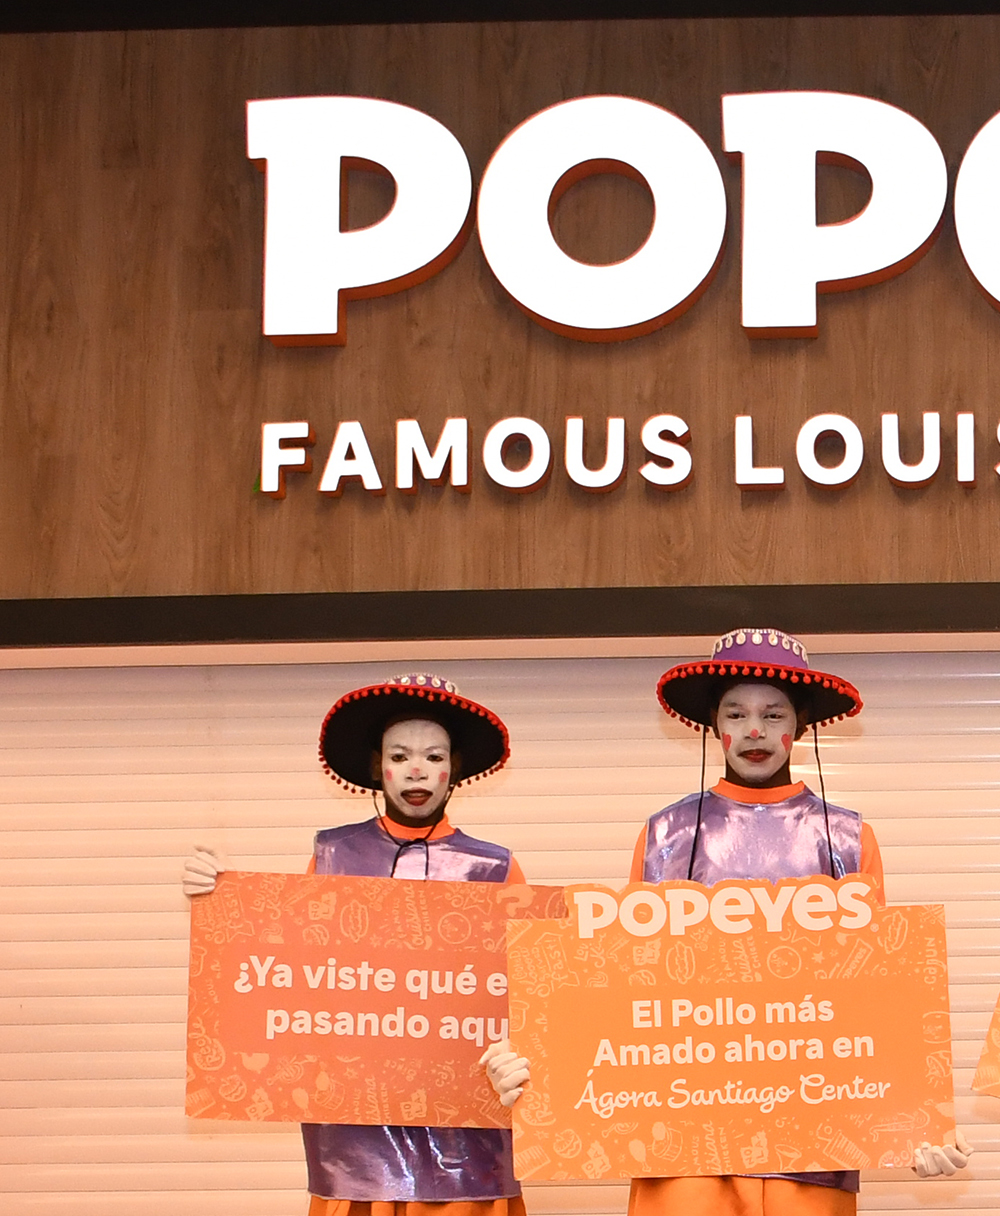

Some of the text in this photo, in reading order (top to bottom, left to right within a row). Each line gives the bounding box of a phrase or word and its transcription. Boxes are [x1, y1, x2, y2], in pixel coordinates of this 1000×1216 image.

[259, 413, 692, 495] FAMOUS
[234, 955, 293, 994] ¿Ya
[302, 957, 396, 992] viste
[405, 964, 477, 1000] qué
[266, 1006, 508, 1048] pasando aqu
[632, 994, 835, 1029] El Pollo más
[593, 1033, 874, 1067] Amado ahora en
[574, 1068, 891, 1119] Ágora Santiago Center
